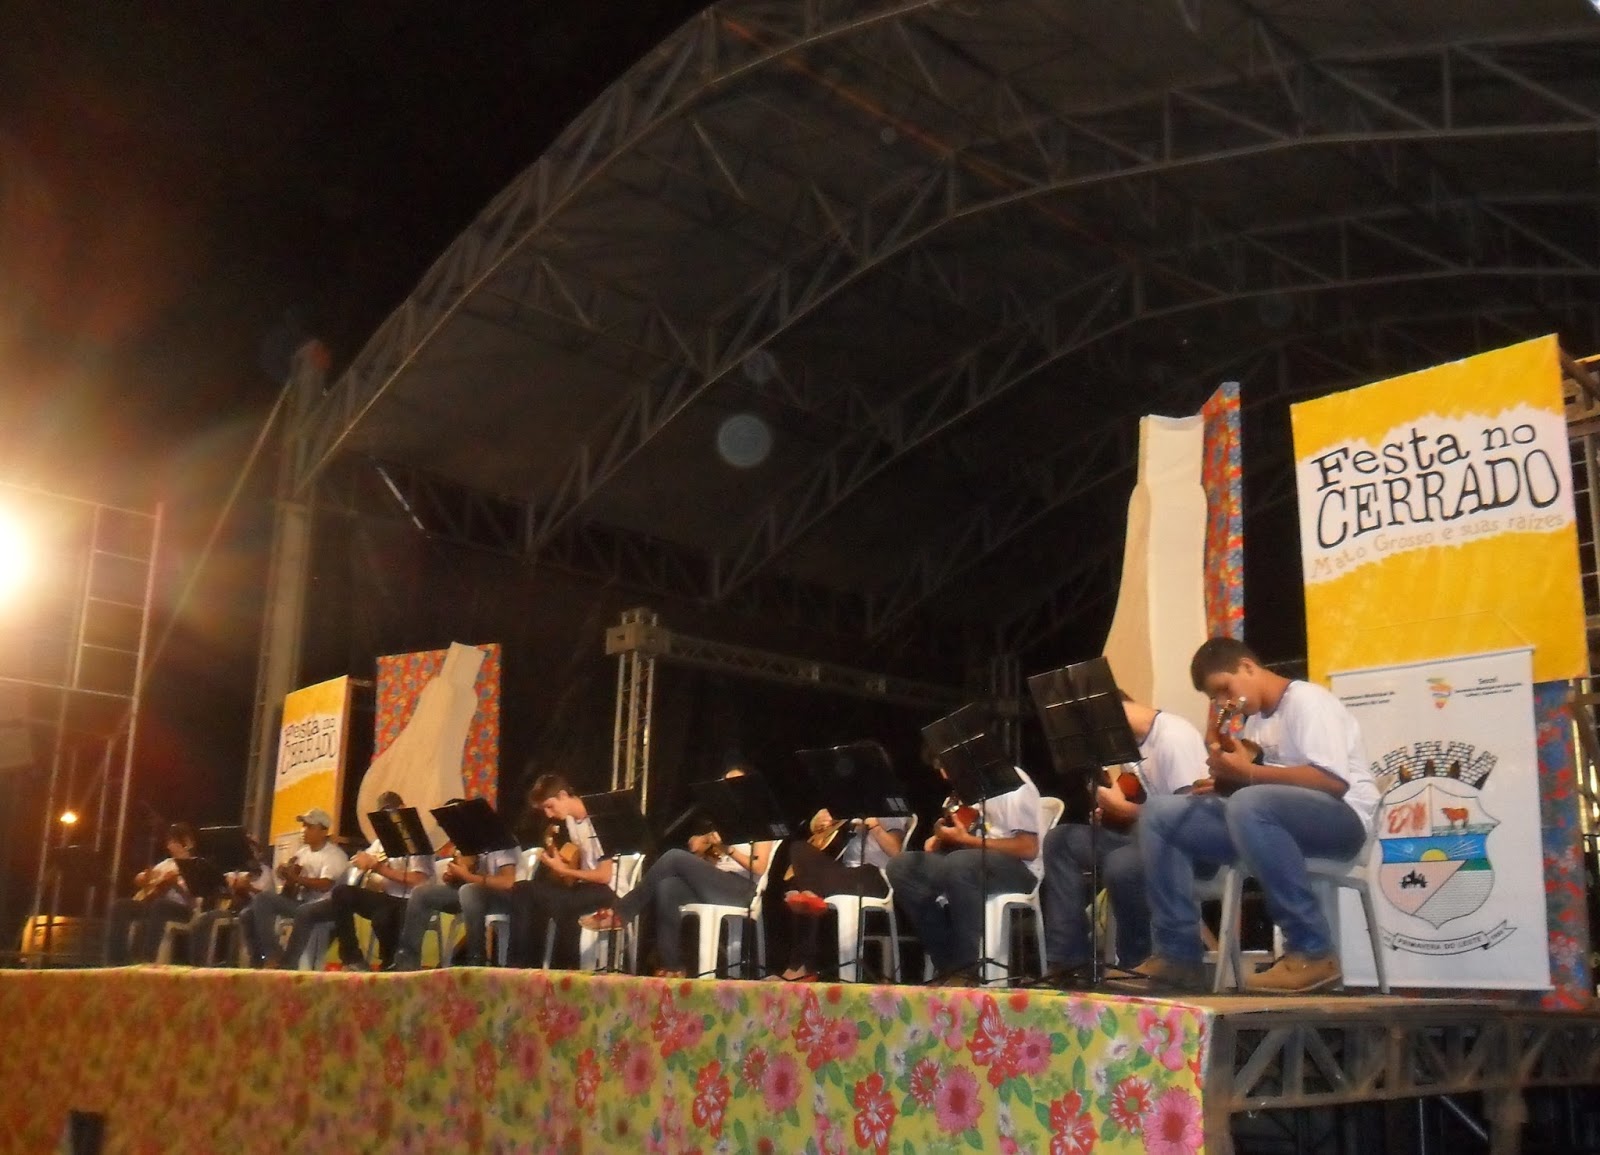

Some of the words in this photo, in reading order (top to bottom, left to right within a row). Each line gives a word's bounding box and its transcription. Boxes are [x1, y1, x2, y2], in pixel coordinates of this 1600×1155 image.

[1311, 427, 1470, 492] Festa
[1483, 423, 1536, 452] no
[1317, 449, 1560, 549] CERRADO
[1311, 546, 1366, 578] Mato
[1374, 531, 1435, 552] Grosso
[1441, 527, 1453, 540] e
[1461, 519, 1499, 537] suas
[281, 730, 337, 775] CERRADO
[284, 719, 320, 746] Festa
[323, 717, 335, 730] no
